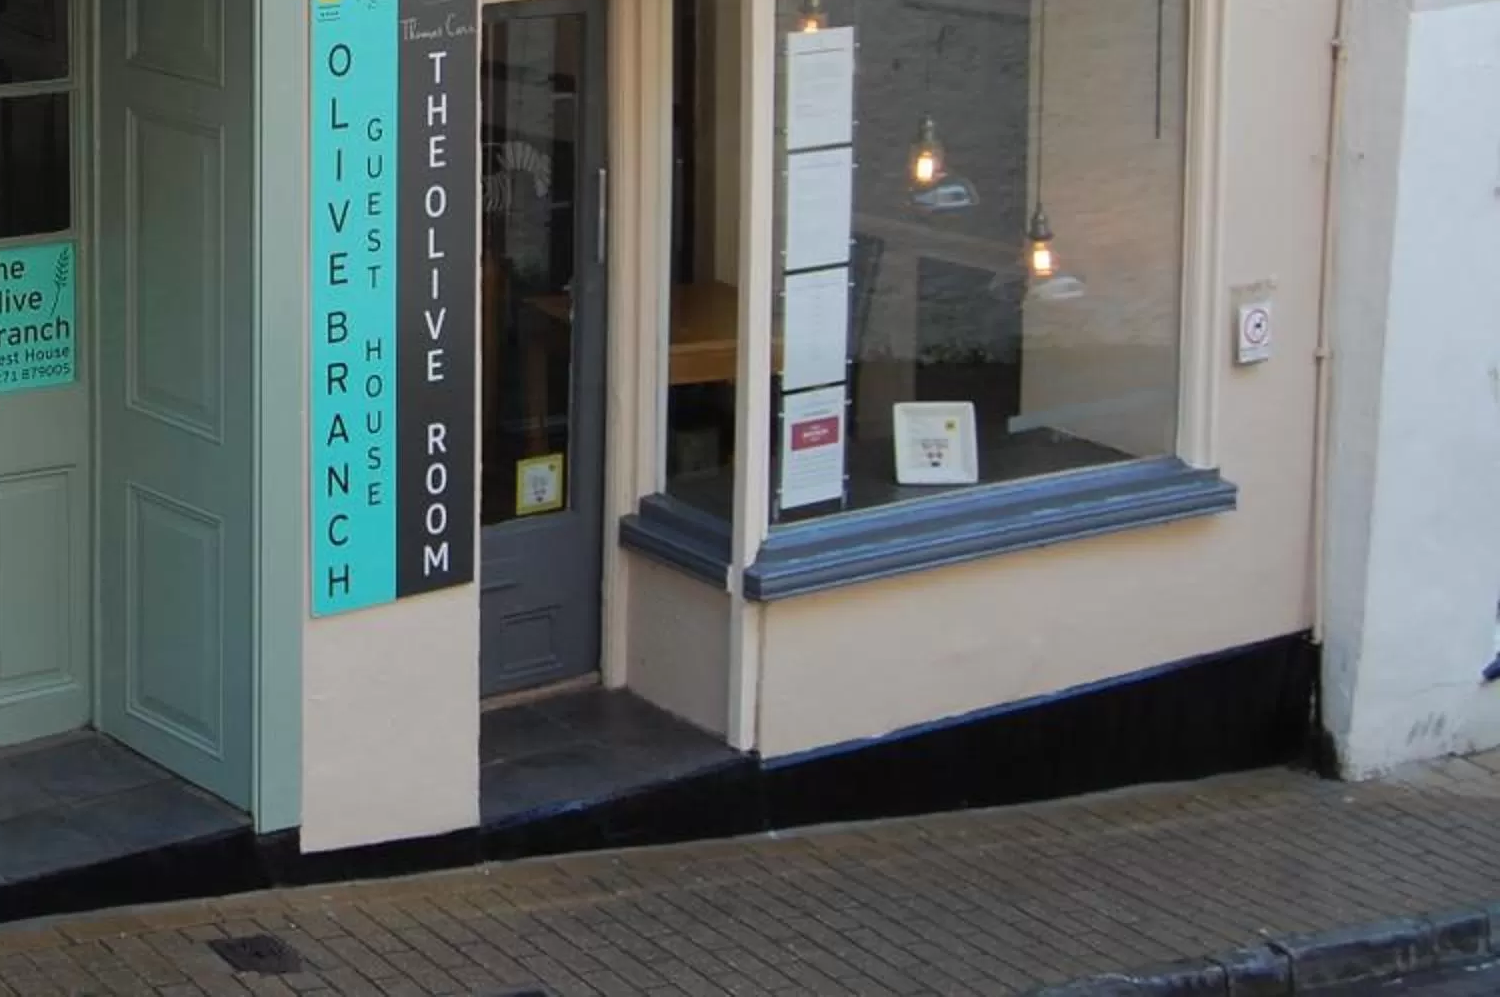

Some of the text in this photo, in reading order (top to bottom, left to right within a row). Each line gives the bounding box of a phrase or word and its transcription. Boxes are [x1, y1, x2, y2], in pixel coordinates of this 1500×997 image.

[328, 43, 351, 286] OLIVE
[22, 363, 70, 380] 879005
[25, 346, 70, 363] House
[365, 117, 383, 506] GUEST HOUSE
[423, 51, 449, 576] THE OLIVE ROOM
[327, 311, 350, 598] BRANCH
